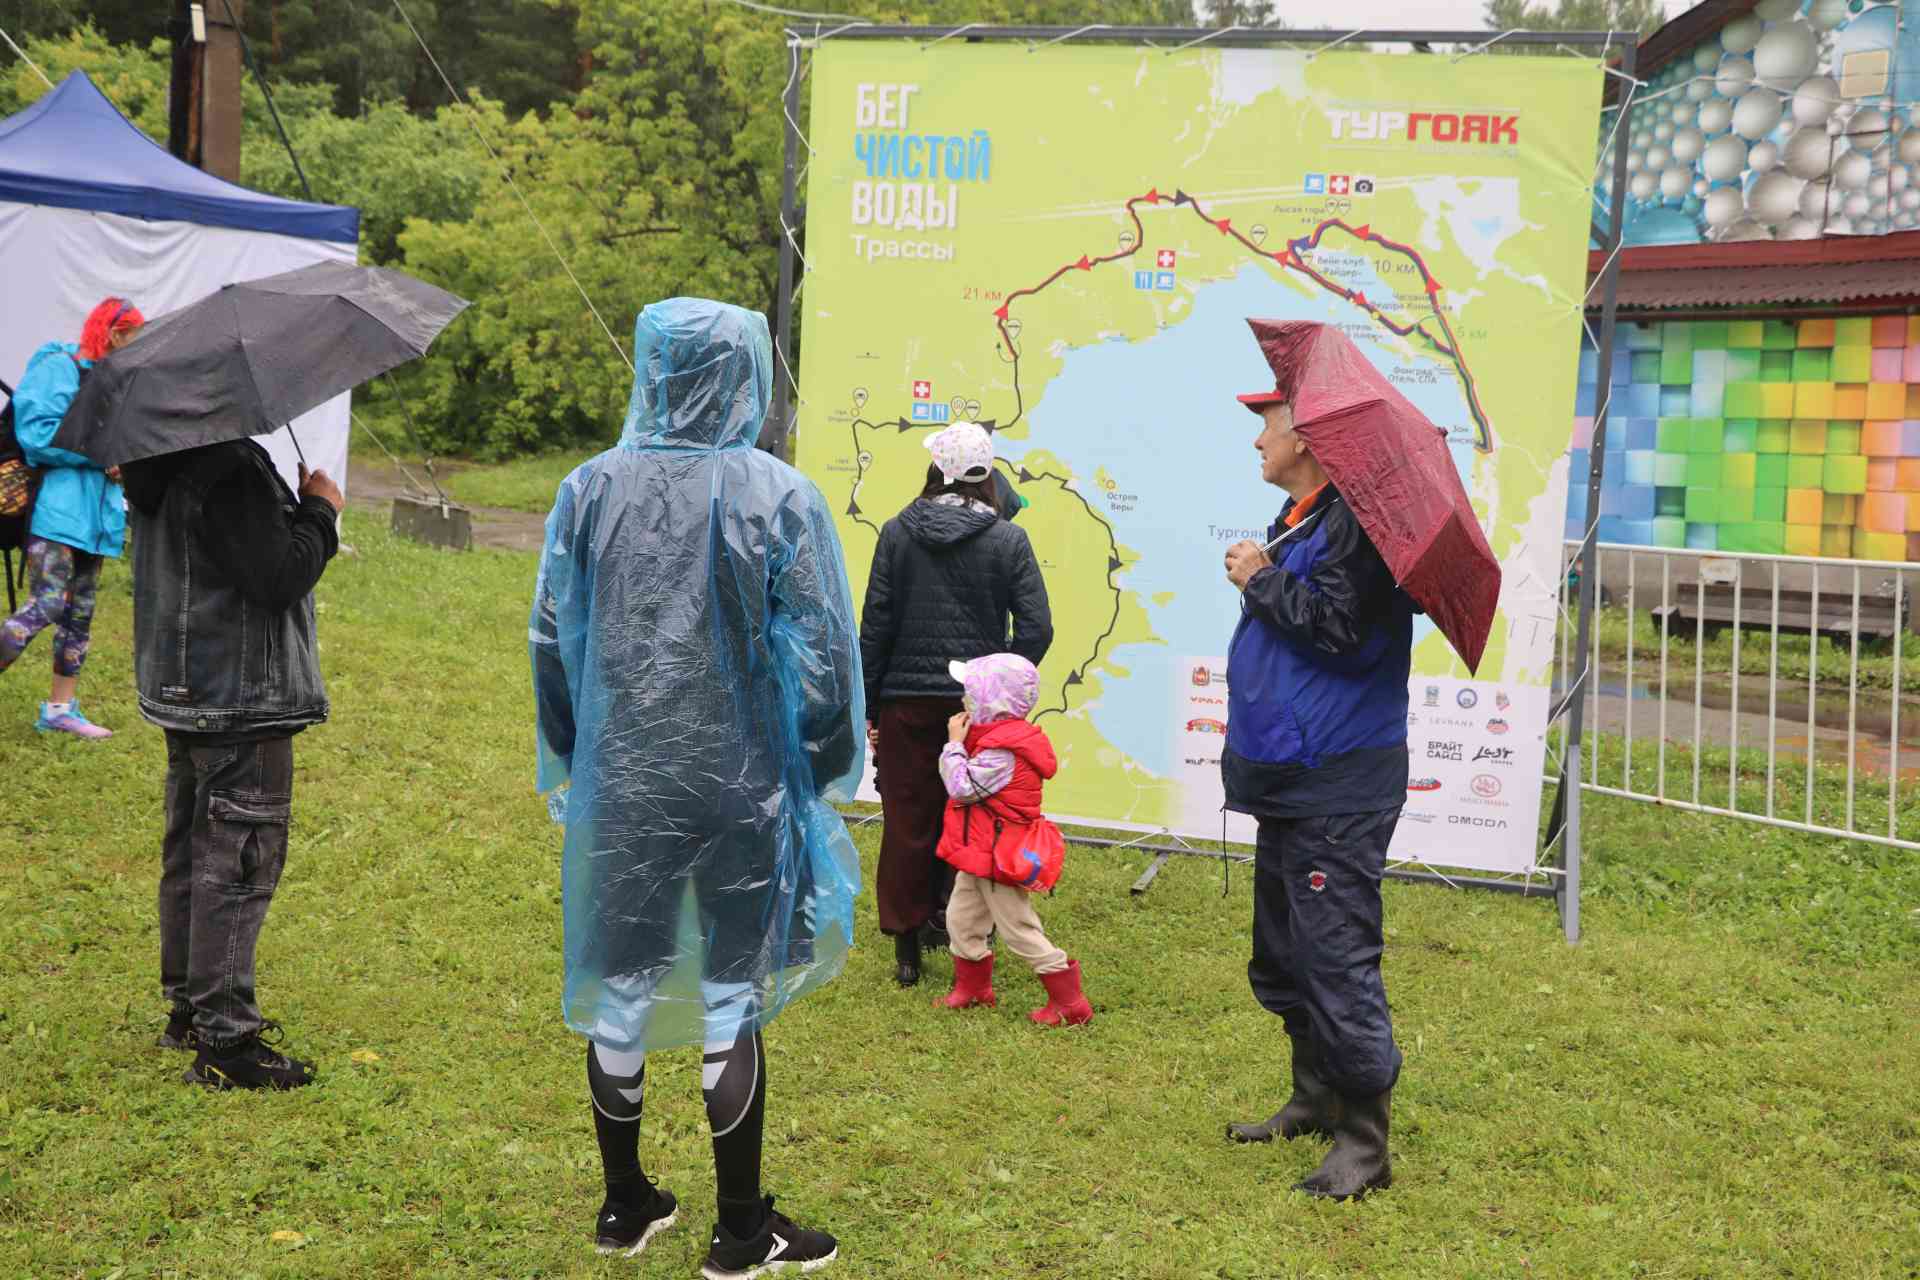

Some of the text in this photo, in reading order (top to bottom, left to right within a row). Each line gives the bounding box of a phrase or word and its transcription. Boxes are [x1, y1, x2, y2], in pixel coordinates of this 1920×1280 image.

[855, 82, 920, 130] БЕГ
[854, 130, 992, 182] ЧИСТОЙ
[851, 181, 959, 231] ВОДЫ
[851, 234, 955, 264] Трассы
[1374, 259, 1415, 274] 10 км
[963, 287, 1002, 301] 21 км
[1456, 326, 1487, 338] 5 км
[1427, 740, 1463, 752] БРАЙТ
